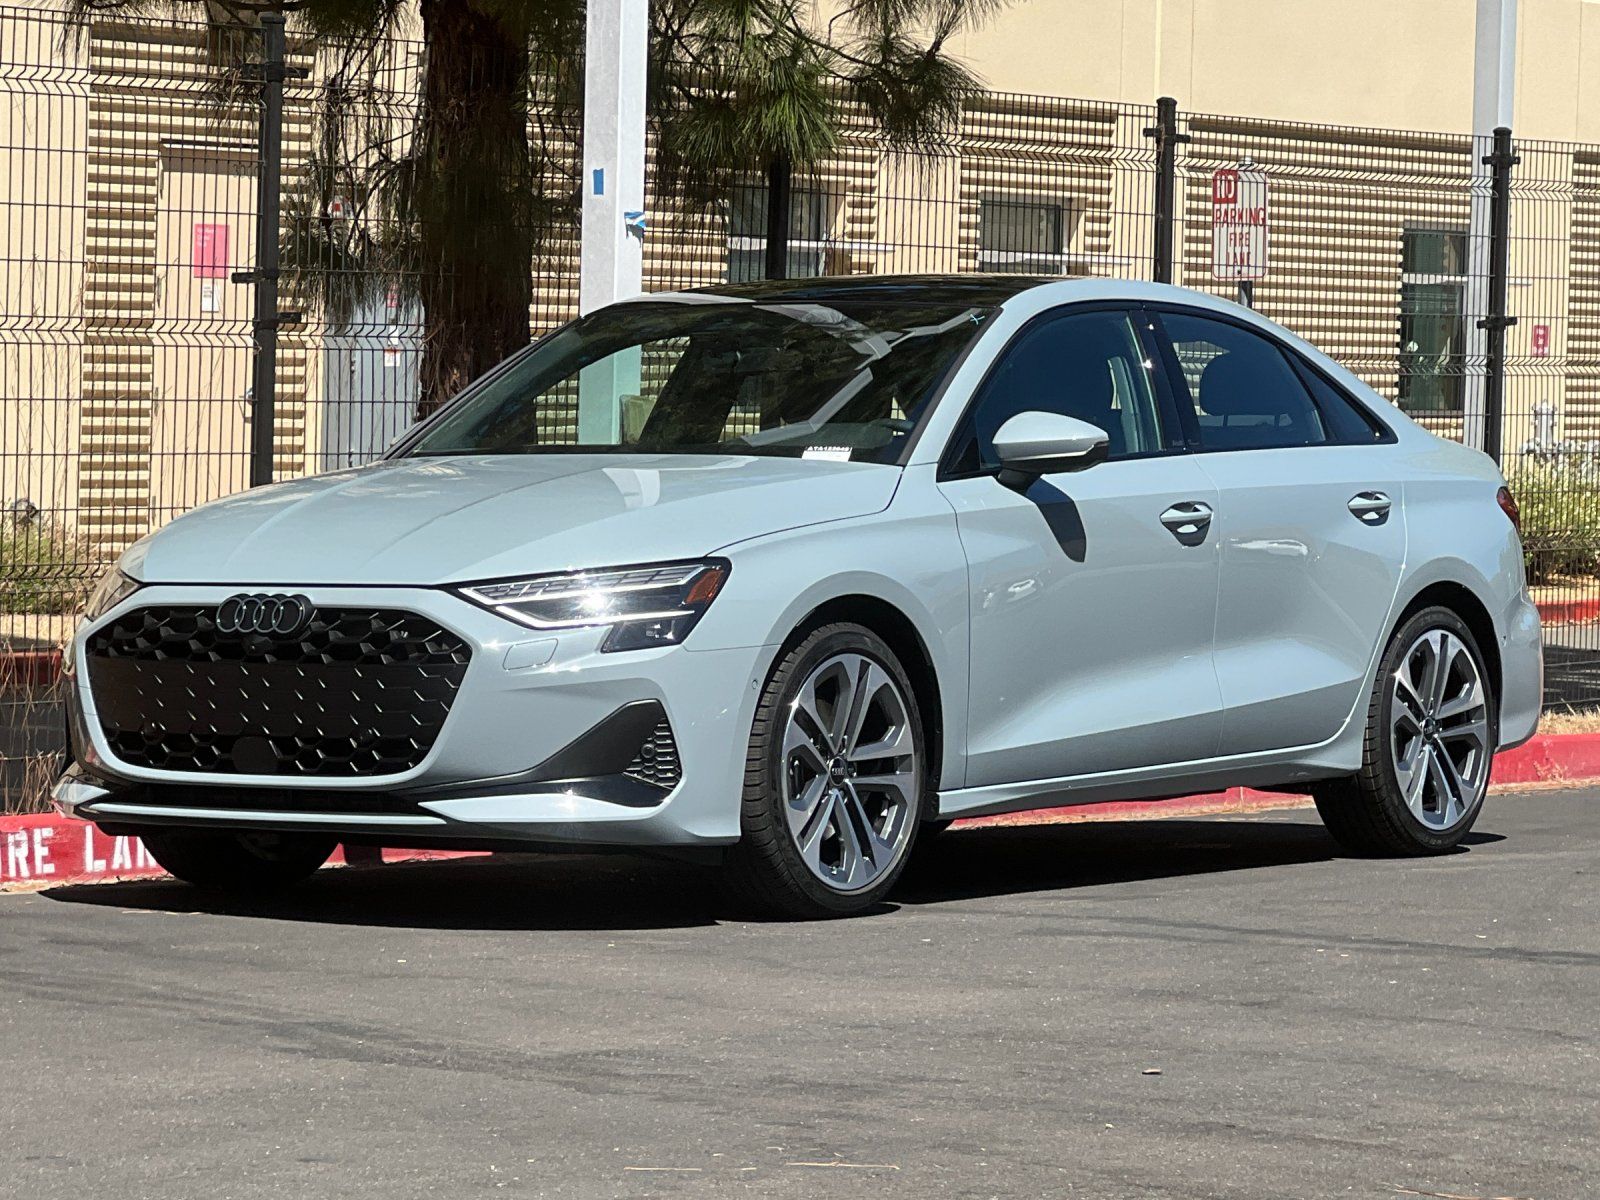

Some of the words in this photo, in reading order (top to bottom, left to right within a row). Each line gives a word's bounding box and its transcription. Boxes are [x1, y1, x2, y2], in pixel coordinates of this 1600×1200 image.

[1215, 207, 1266, 228] PARKING
[1229, 231, 1251, 248] FIRE
[1227, 251, 1251, 267] LANE
[0, 827, 55, 878] RE
[84, 824, 157, 872] LAN
